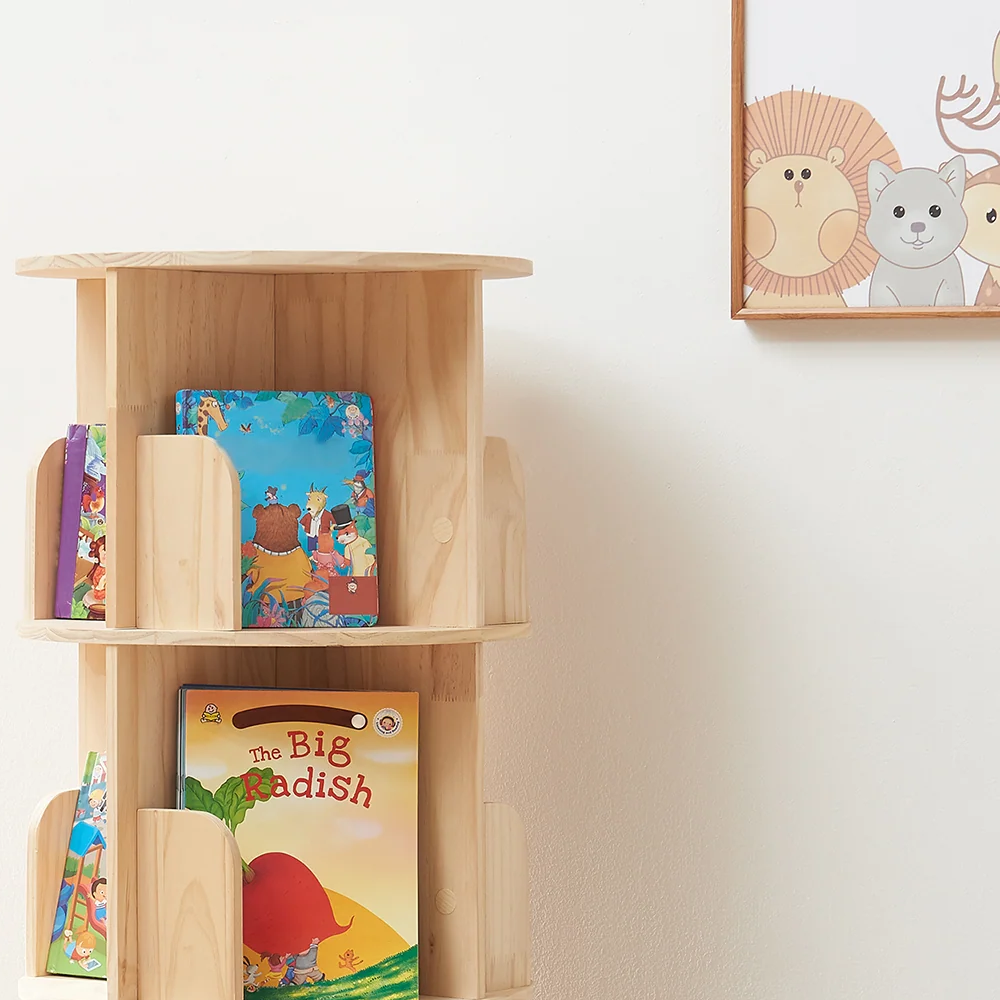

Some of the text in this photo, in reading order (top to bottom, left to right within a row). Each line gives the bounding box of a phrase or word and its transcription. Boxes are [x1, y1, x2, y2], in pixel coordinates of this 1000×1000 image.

[249, 730, 351, 768] The Big
[240, 766, 372, 809] Radish
